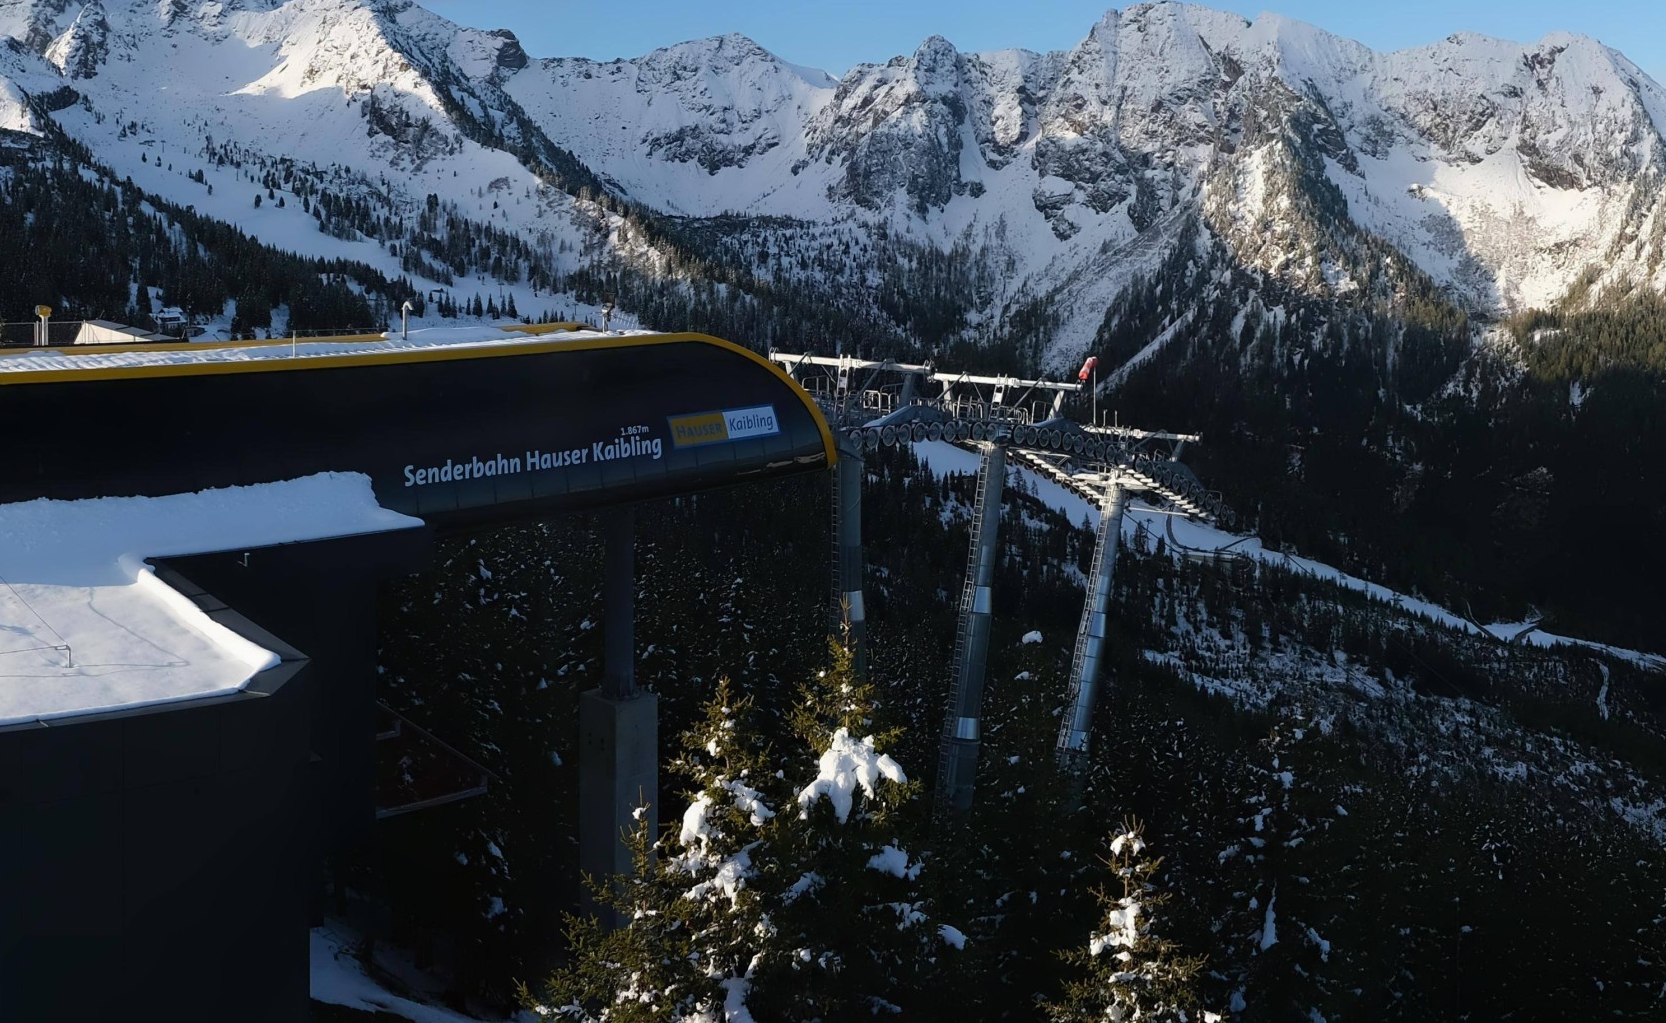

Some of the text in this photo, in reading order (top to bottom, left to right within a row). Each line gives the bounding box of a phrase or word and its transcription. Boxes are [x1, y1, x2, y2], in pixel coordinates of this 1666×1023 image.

[620, 425, 650, 436] 1.867m
[676, 414, 774, 439] HAUSER Kaibling
[403, 434, 663, 487] Senderbahn Hauser Kaibling
